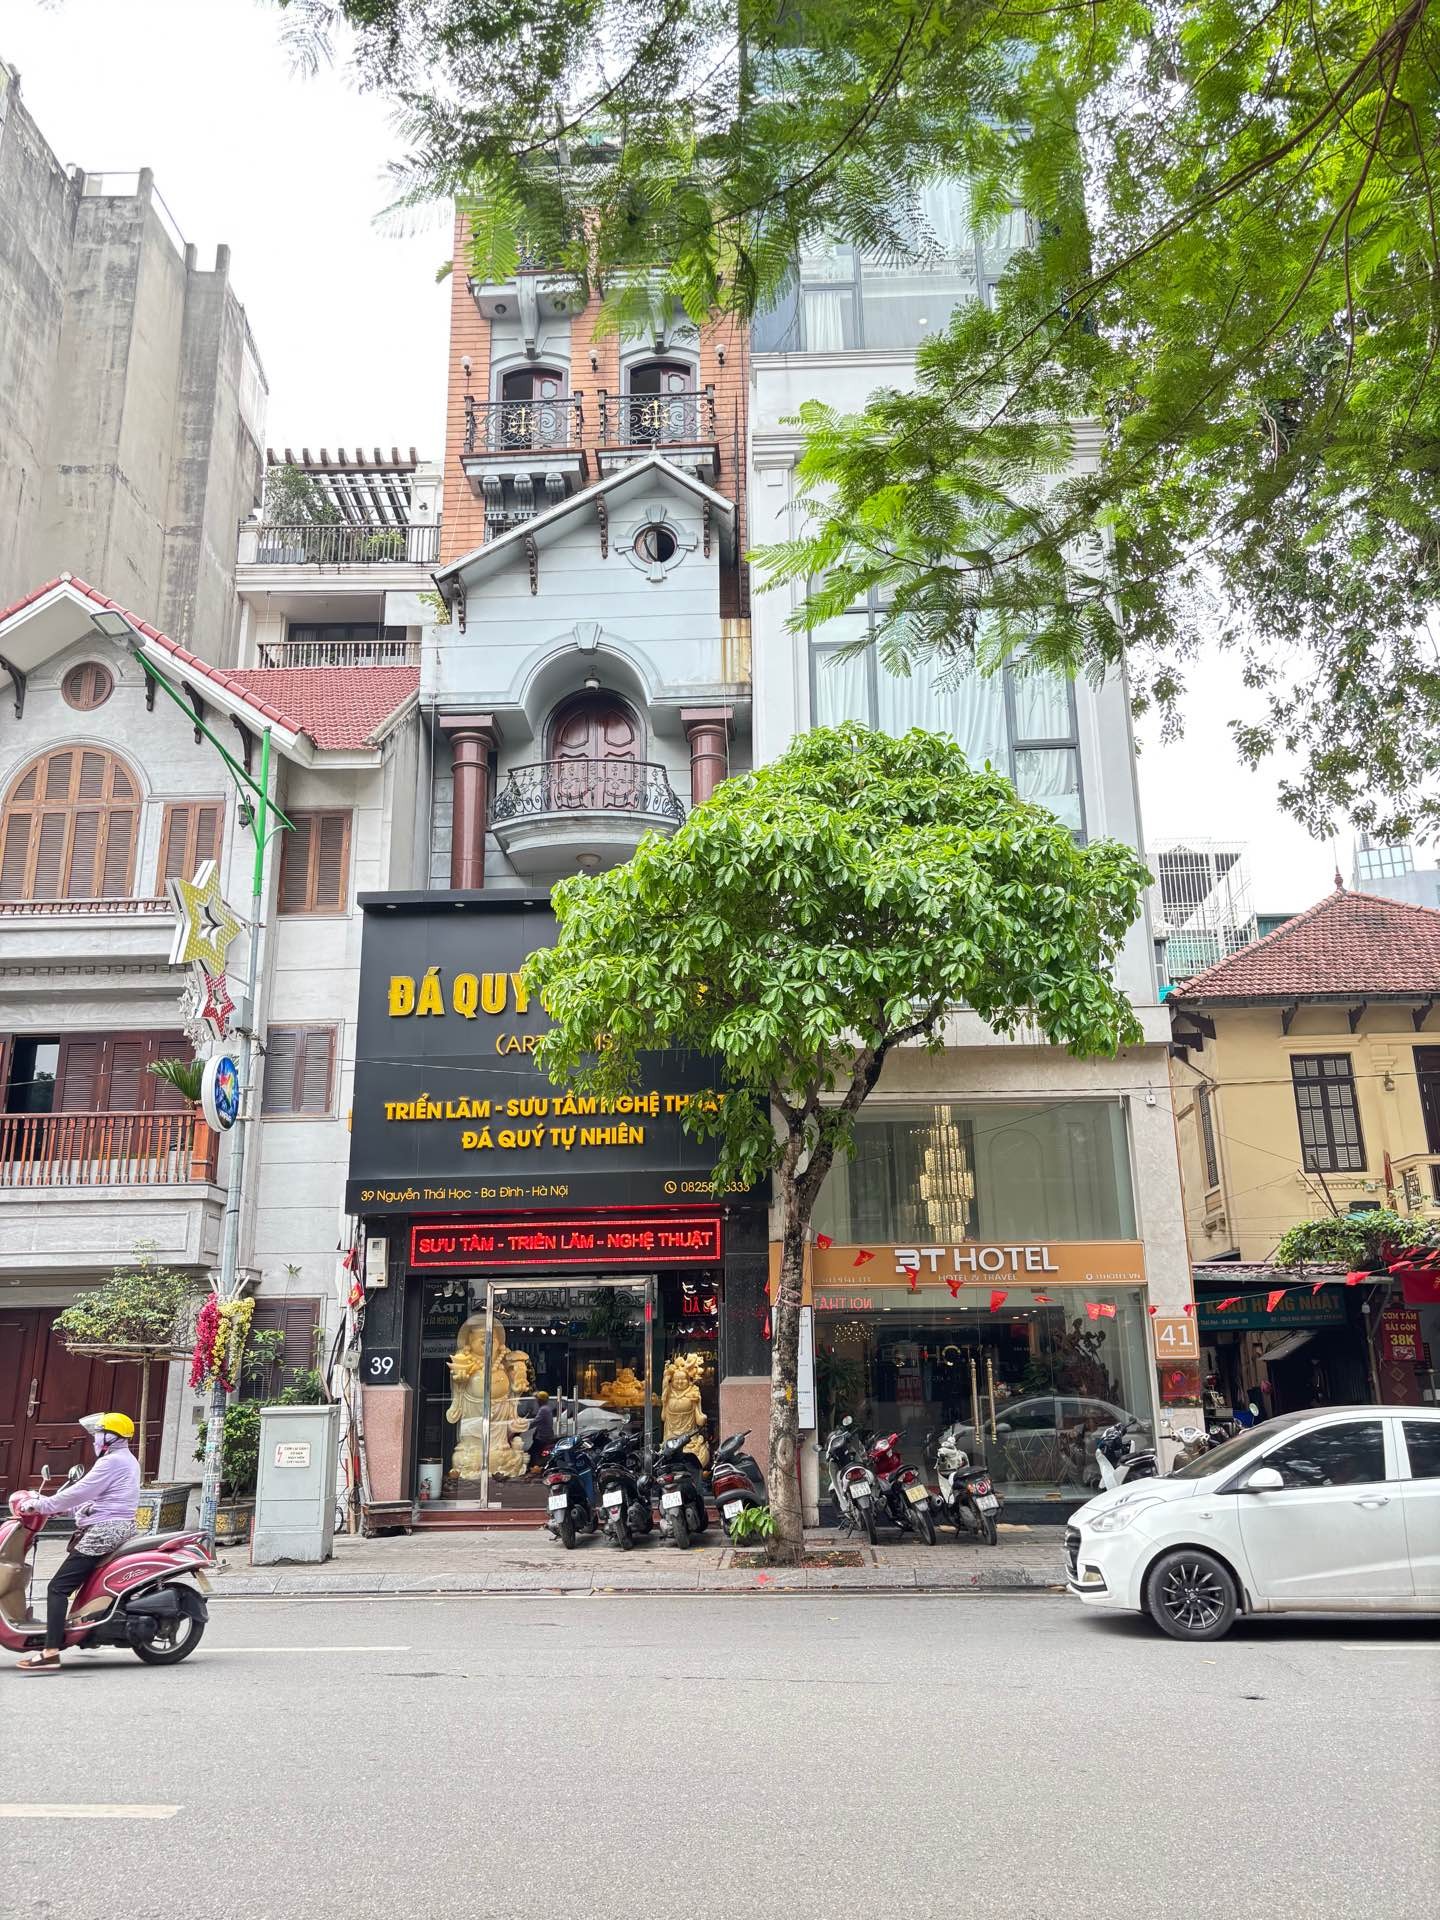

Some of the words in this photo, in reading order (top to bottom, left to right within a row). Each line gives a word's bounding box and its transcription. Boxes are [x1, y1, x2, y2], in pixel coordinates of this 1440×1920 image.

[387, 966, 445, 1017] ĐÁ
[384, 1092, 442, 1121] TRIỂN
[445, 1096, 491, 1119] LÃM
[506, 1096, 548, 1117] SƯU
[552, 1088, 596, 1116] TẦM
[462, 1125, 494, 1150] ĐÁ
[498, 1122, 545, 1149] QUÝ
[550, 1125, 576, 1151] TỰ
[580, 1121, 644, 1146] NHIÊN
[361, 1190, 375, 1201] 39
[376, 1187, 420, 1203] Nguyễn
[424, 1187, 446, 1200] Thái
[448, 1188, 472, 1200] Học
[480, 1187, 496, 1198] Ba
[500, 1186, 524, 1198] Đình
[532, 1184, 548, 1197] Hà
[550, 1184, 569, 1198] Nội
[658, 1230, 713, 1250] THUẬT
[953, 1246, 1060, 1272] HOTEL
[984, 1272, 1017, 1282] TRAVEL
[1160, 1324, 1193, 1346] 41
[1390, 1334, 1415, 1346] 38K
[370, 1356, 394, 1375] 39
